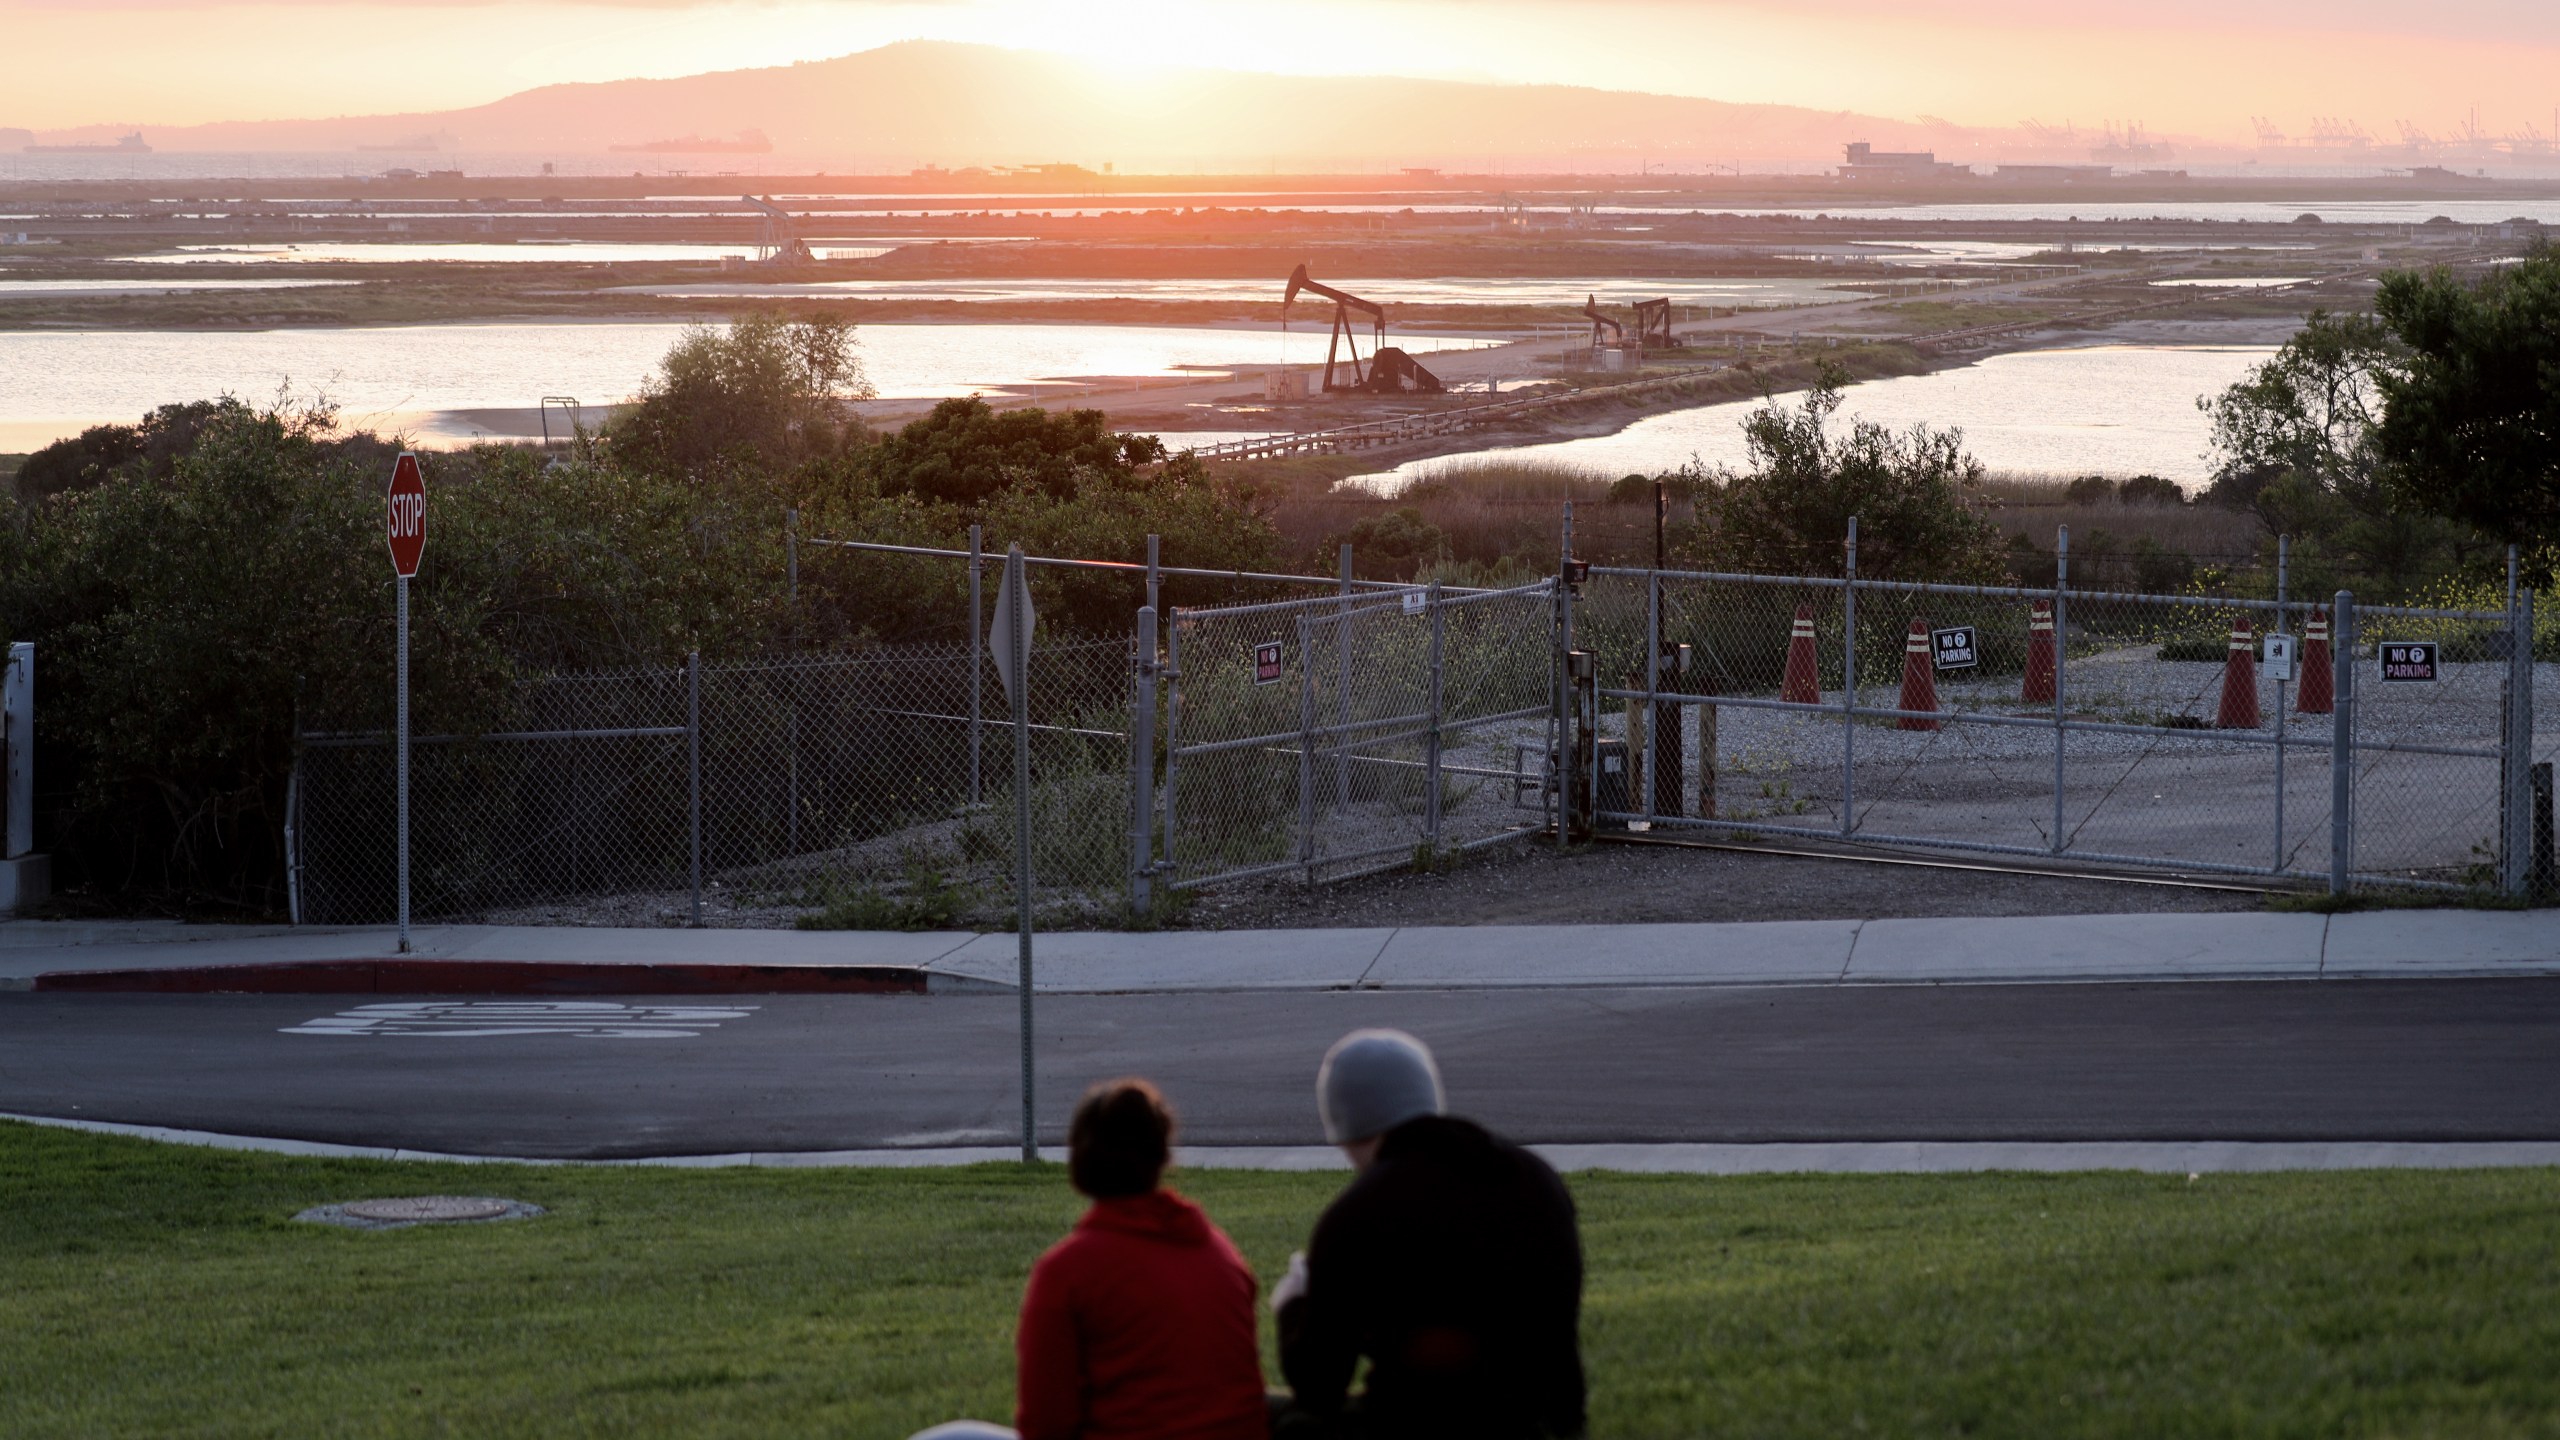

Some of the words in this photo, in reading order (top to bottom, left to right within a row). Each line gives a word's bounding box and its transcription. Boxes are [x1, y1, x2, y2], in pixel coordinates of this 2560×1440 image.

[391, 493, 422, 537] STOP
[1942, 635, 1952, 648] NO
[1940, 648, 1971, 662] PARKING
[2392, 648, 2405, 662] NO
[2387, 664, 2431, 678] PARKING
